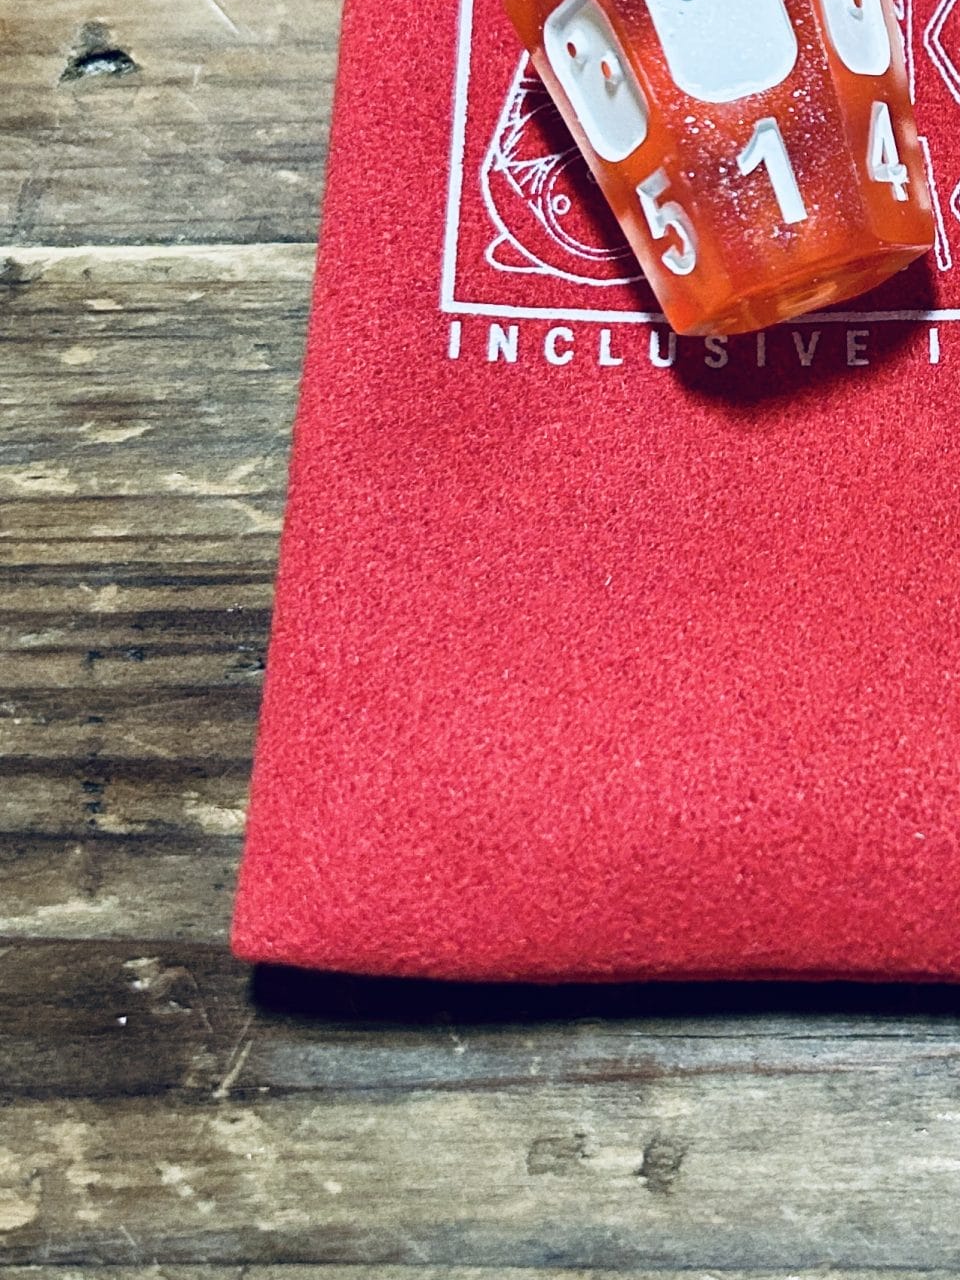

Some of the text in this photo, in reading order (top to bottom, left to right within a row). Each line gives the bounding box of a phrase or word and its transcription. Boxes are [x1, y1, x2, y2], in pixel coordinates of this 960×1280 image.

[736, 117, 808, 224] 1
[866, 100, 909, 201] 4
[636, 166, 697, 275] 5
[447, 320, 870, 368] INCLUSIVE
